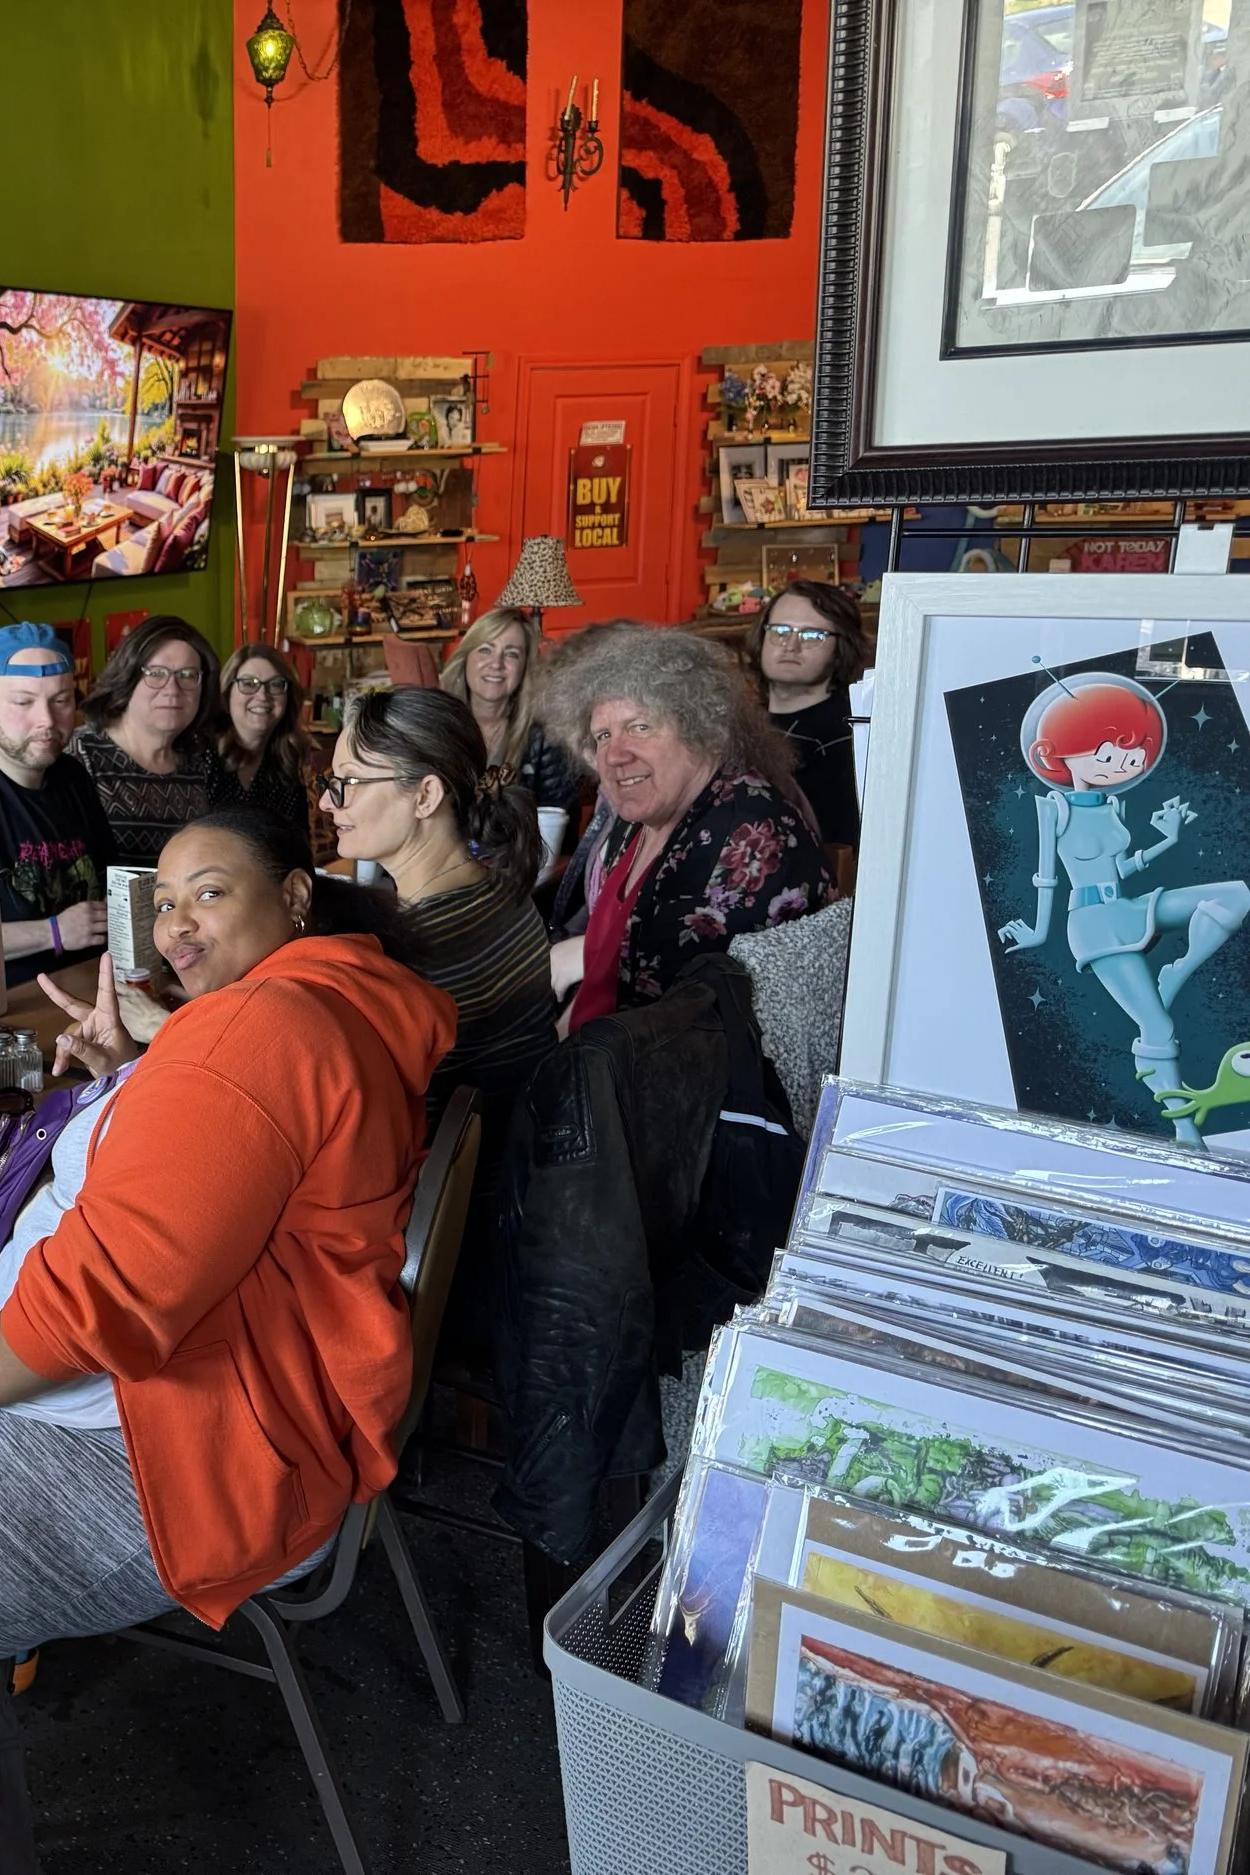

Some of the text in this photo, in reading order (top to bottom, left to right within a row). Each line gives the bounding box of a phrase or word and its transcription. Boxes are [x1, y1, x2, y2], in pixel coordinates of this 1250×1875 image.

[576, 477, 622, 505] BUY
[575, 513, 621, 528] SUPPORT
[574, 527, 619, 547] LOCAL
[1083, 541, 1167, 553] NOT TODAY
[1081, 553, 1167, 571] KAREN
